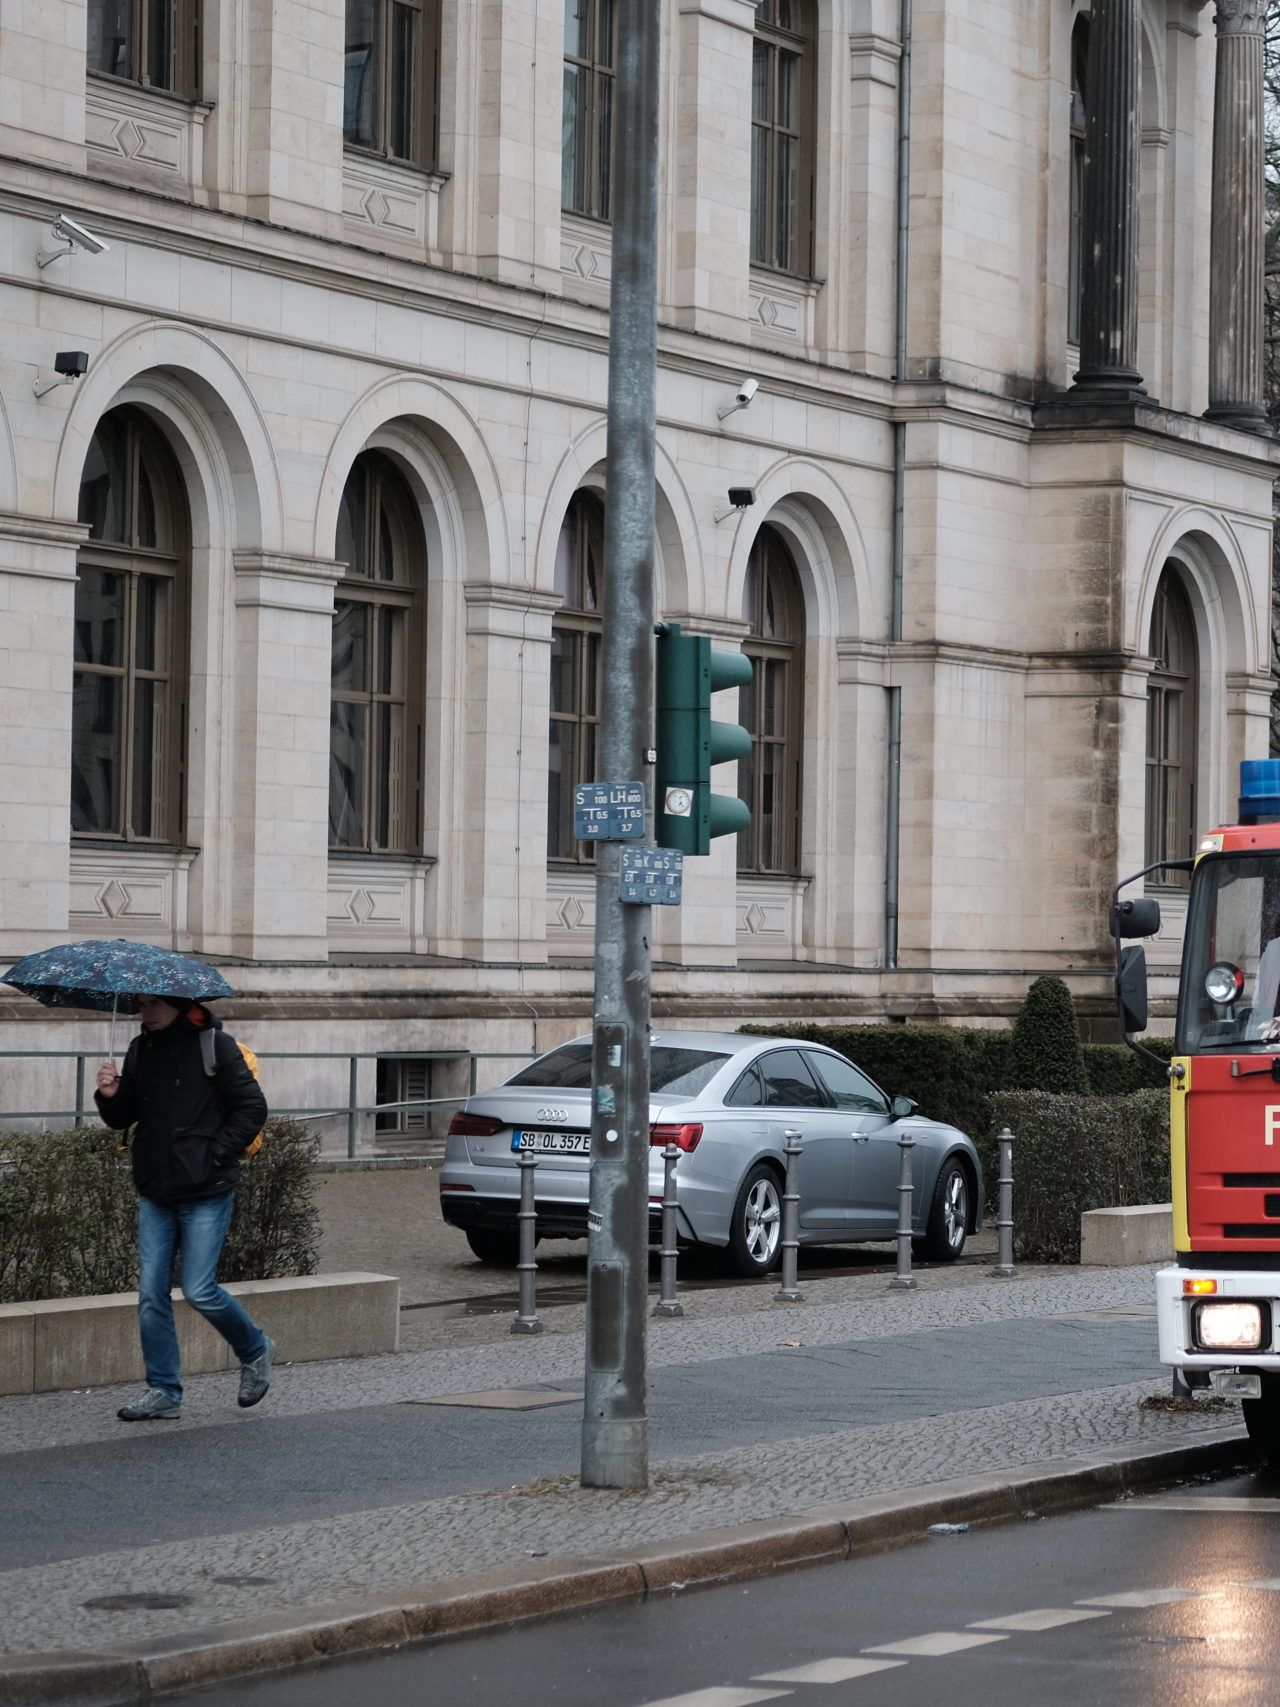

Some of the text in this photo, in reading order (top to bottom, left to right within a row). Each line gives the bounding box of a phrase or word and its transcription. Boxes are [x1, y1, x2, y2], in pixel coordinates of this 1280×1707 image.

[576, 793, 585, 804] S
[610, 791, 626, 803] LH
[520, 1133, 535, 1147] SB
